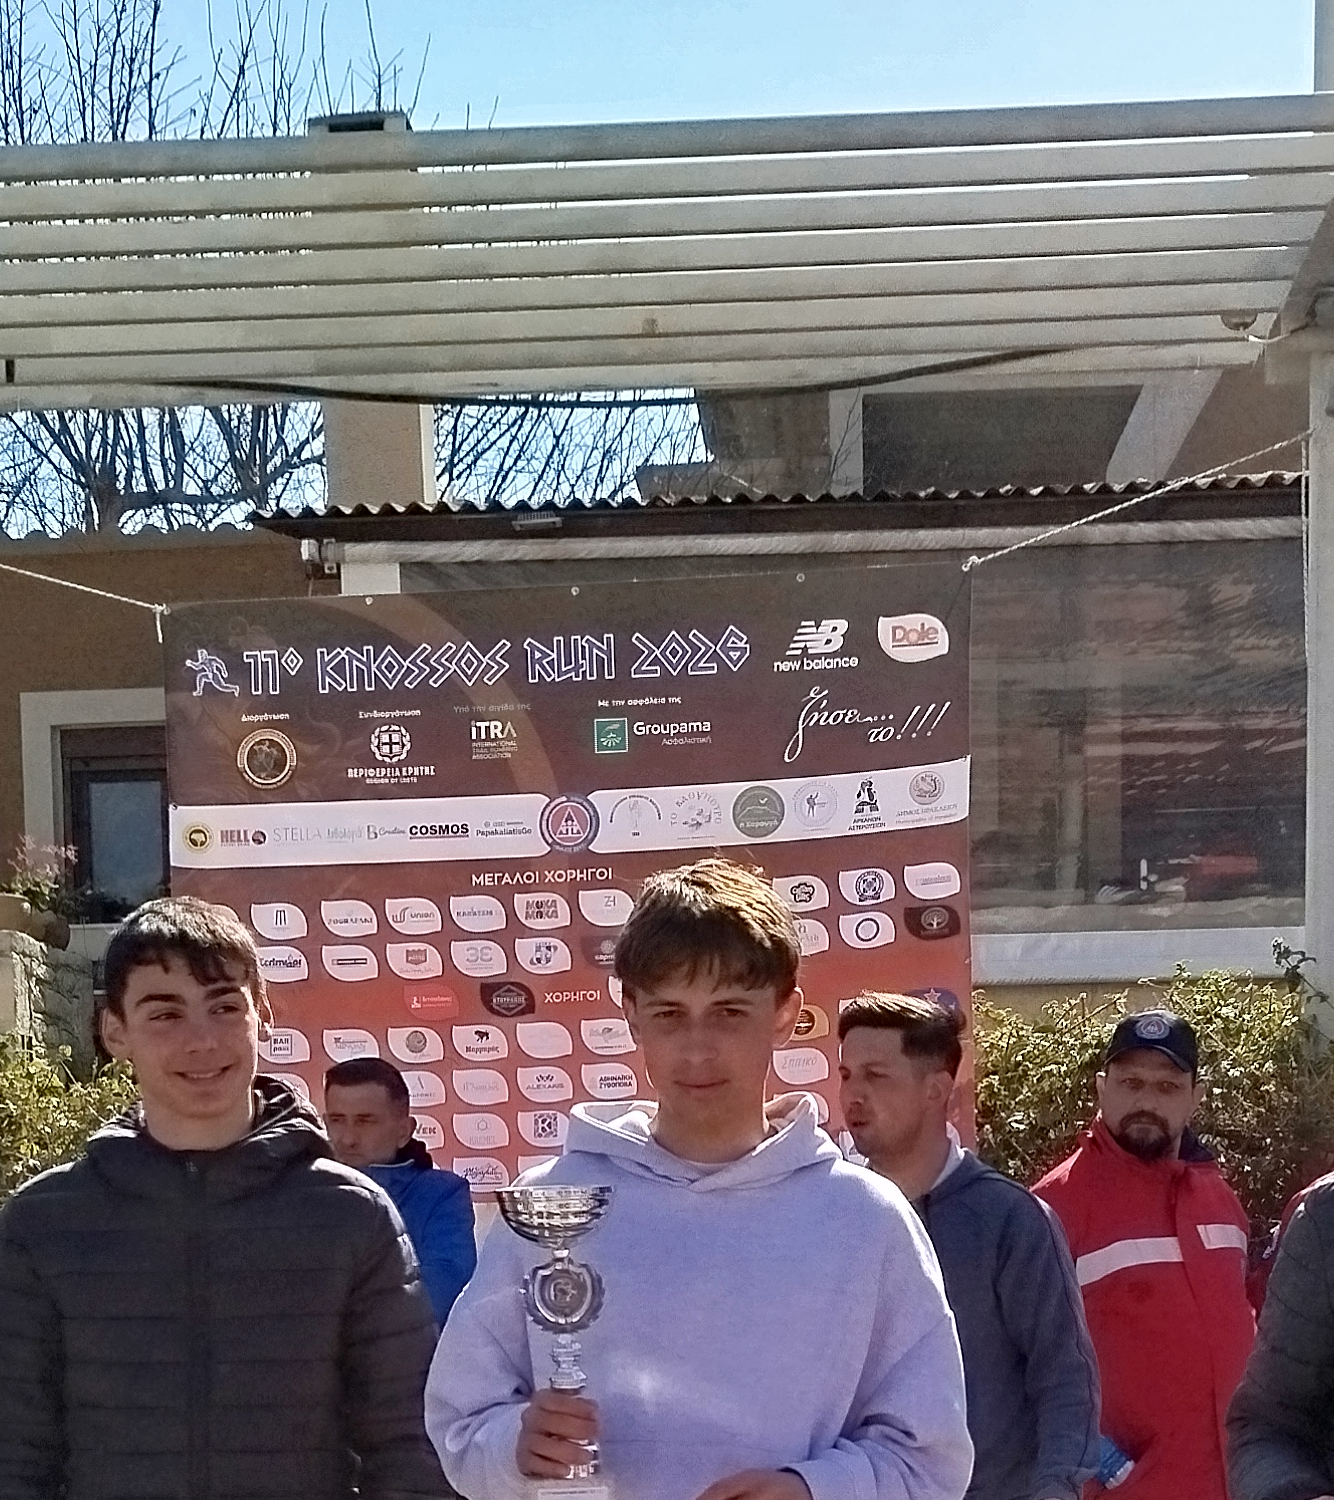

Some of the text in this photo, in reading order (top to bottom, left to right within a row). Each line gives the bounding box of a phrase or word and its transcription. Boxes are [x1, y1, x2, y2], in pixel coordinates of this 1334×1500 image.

[891, 622, 940, 645] Dole
[317, 639, 511, 694] KNOSSOS
[524, 633, 615, 684] RUN
[631, 624, 751, 678] 2026
[773, 655, 859, 672] new balance
[633, 720, 712, 737] Groupama
[272, 827, 323, 842] STELLA
[408, 822, 470, 837] COSMOS
[471, 867, 614, 887] ΜΕΓΑΛΟΙ ΧΟΡΗΓΟΙ
[544, 989, 601, 1004] ΧΟΡΗΓΟΙ
